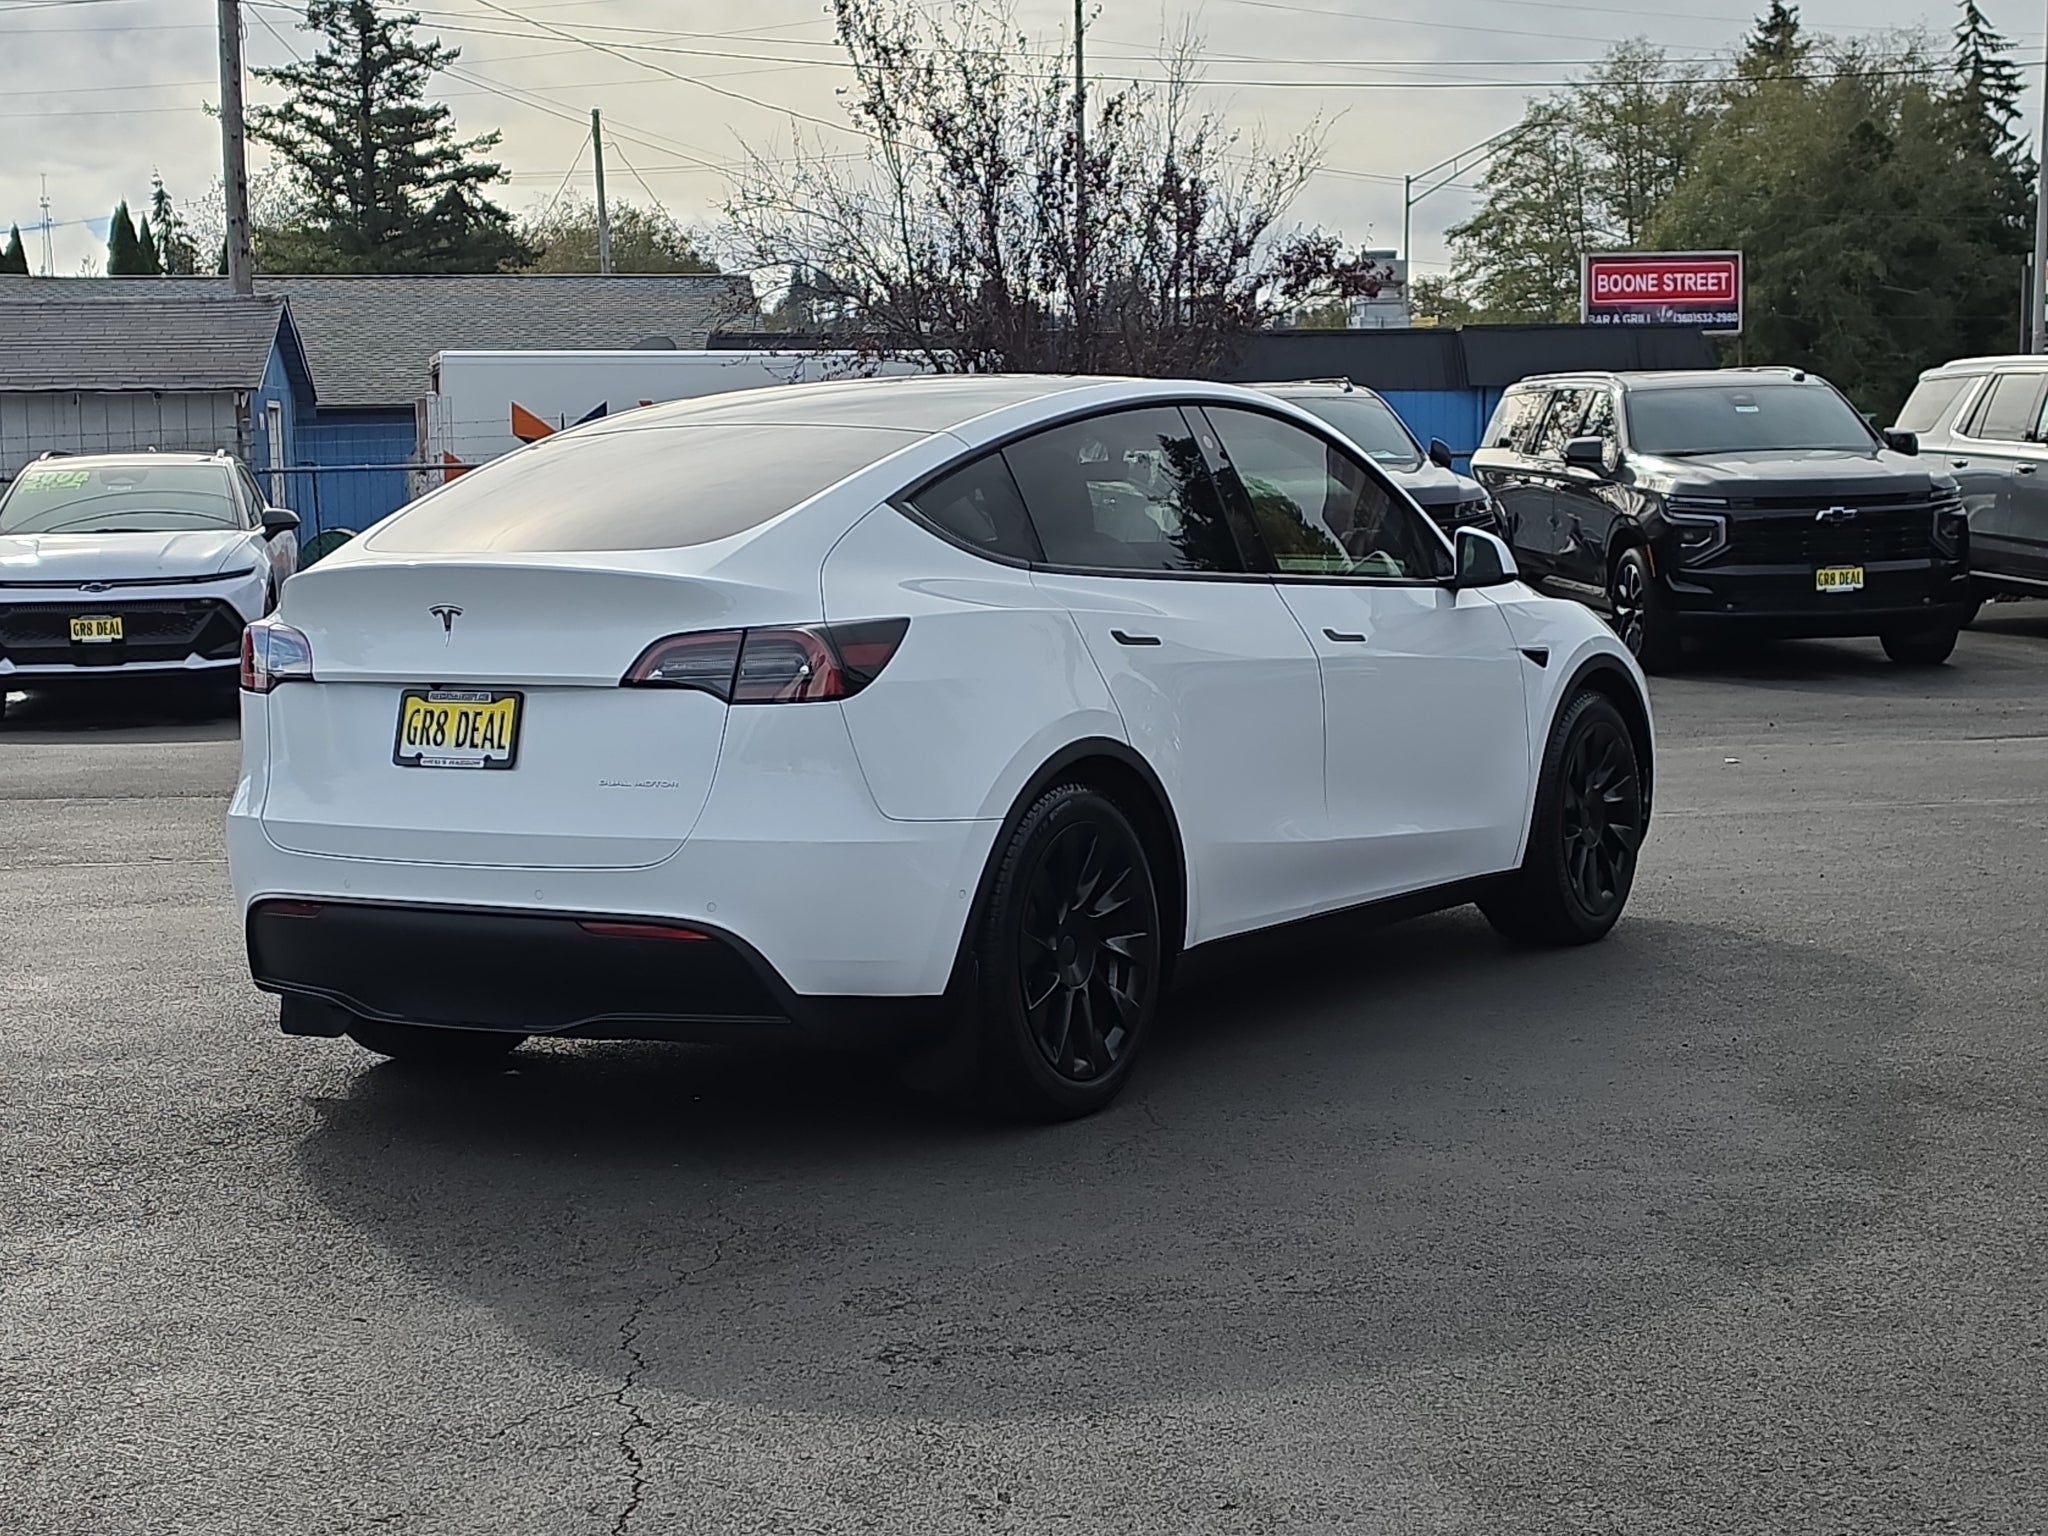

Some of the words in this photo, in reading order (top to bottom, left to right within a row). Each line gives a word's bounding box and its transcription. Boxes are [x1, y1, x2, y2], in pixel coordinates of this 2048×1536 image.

[1597, 273, 1660, 293] BOONE
[1662, 272, 1730, 292] STREET
[1587, 314, 1611, 325] BAR
[1817, 571, 1836, 587] GR8
[1839, 570, 1862, 586] DEAL
[73, 621, 94, 637] GR8
[96, 620, 121, 636] DEAL
[406, 707, 450, 747] GR8
[453, 709, 507, 750] DEAL
[634, 780, 680, 788] MOTOR
